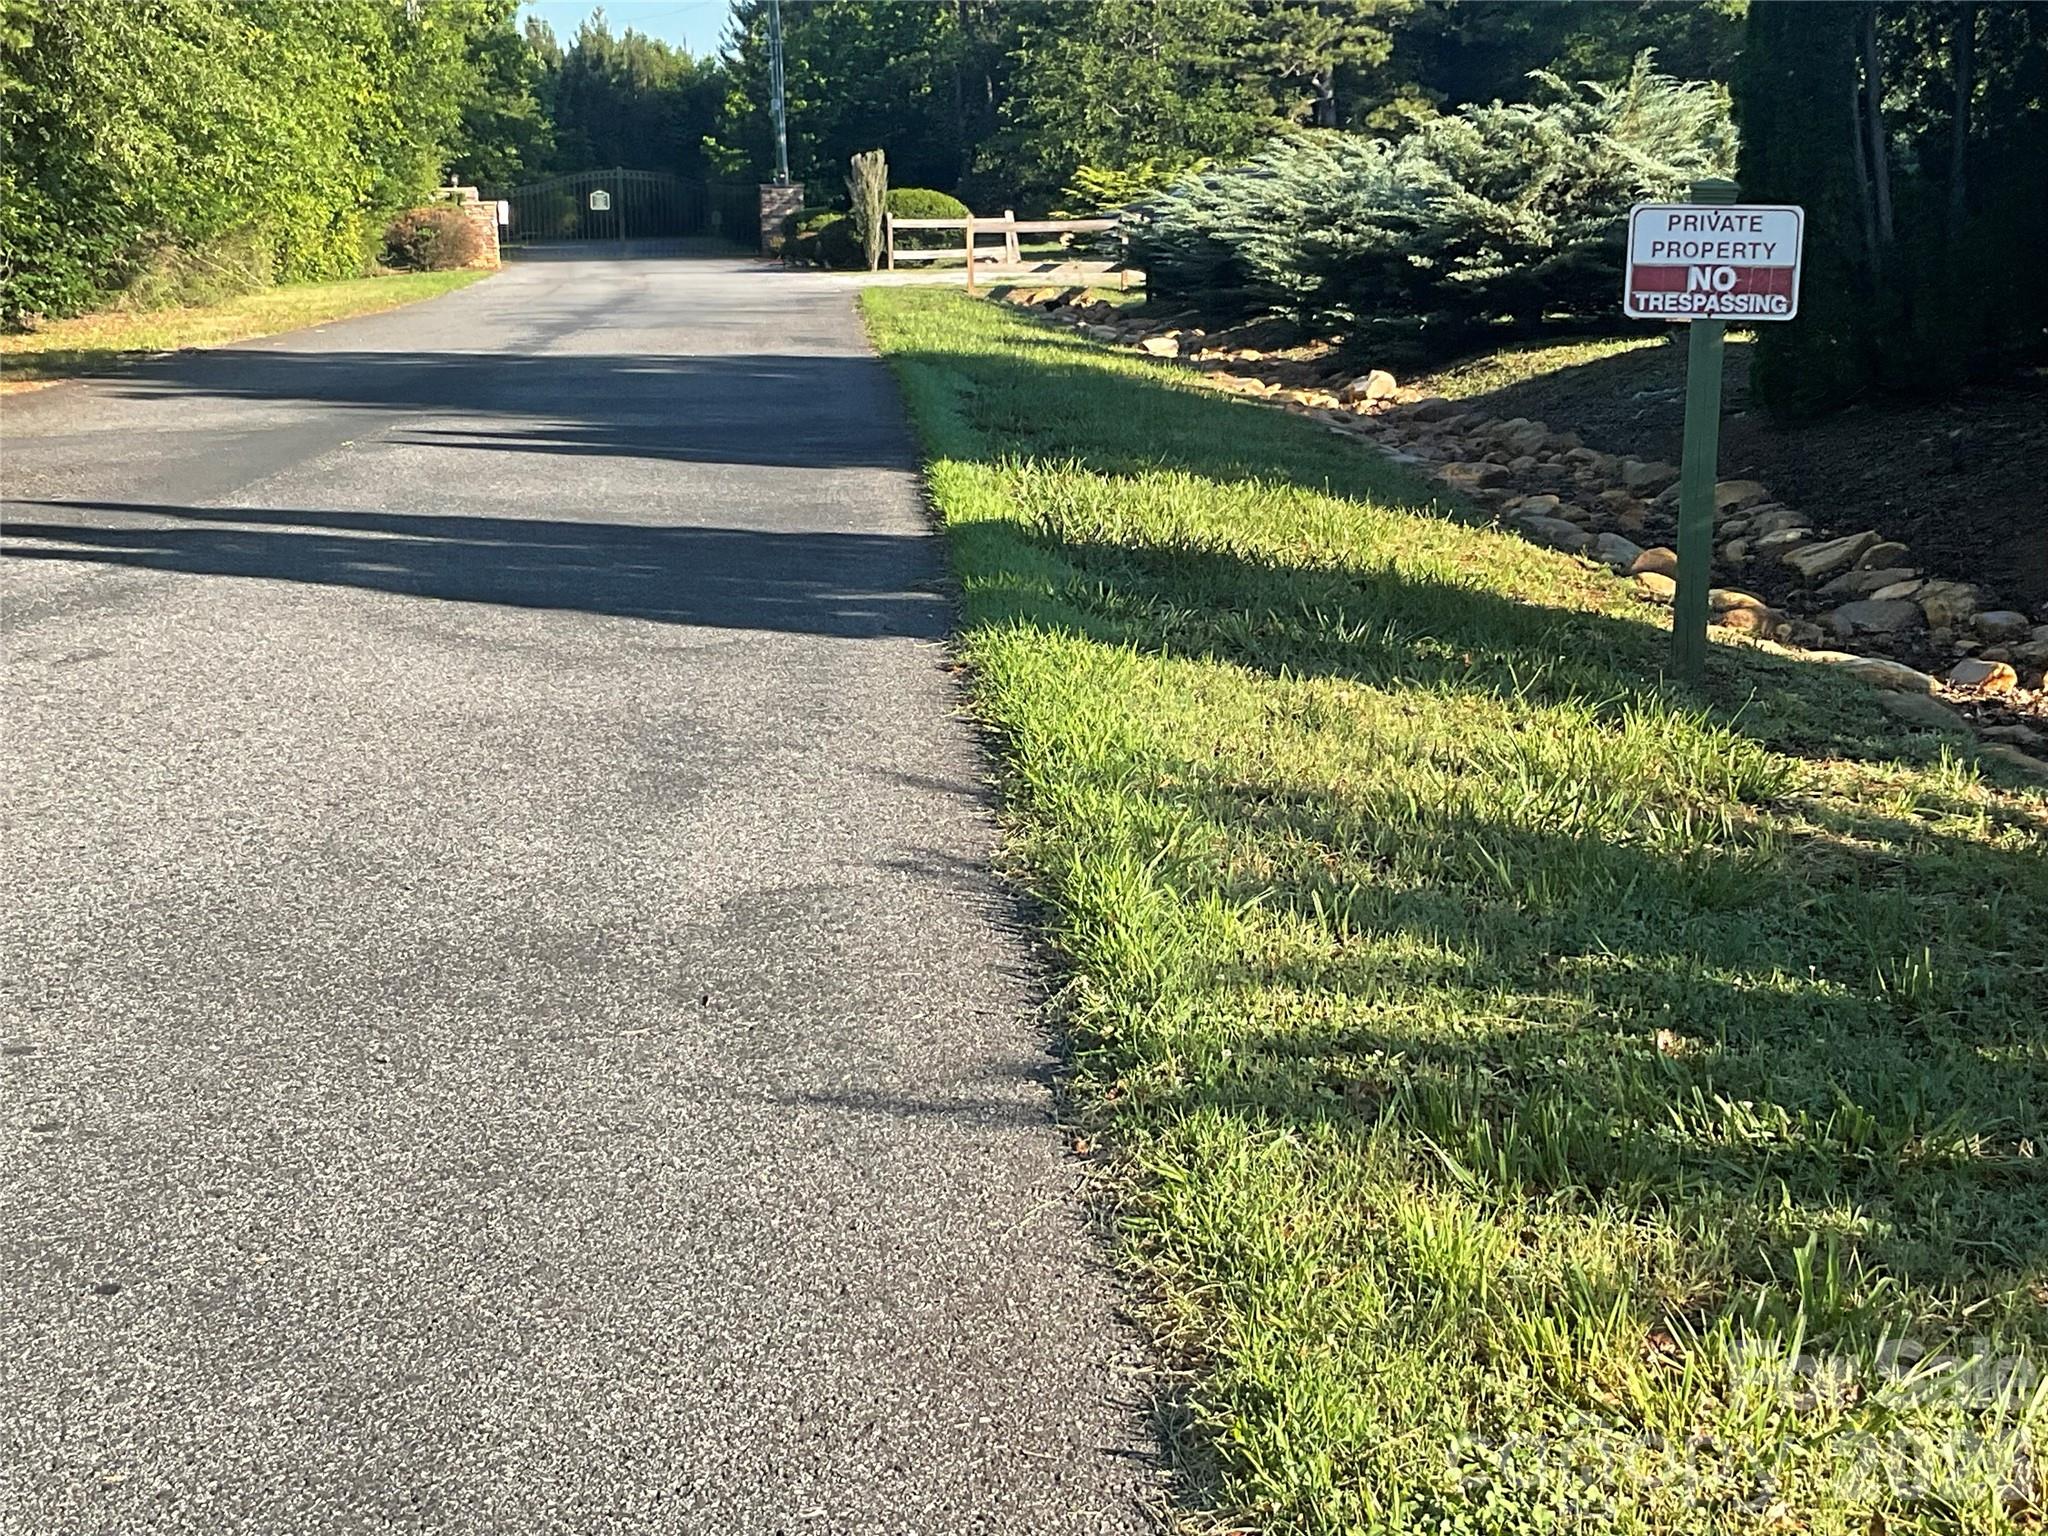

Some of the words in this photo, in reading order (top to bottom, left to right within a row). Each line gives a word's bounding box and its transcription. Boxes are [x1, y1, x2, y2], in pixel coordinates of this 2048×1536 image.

[1668, 215, 1763, 233] PRIVATE
[1651, 241, 1777, 259] PROPERTY
[1688, 266, 1737, 292] NO
[1635, 292, 1788, 313] TRESPASSING
